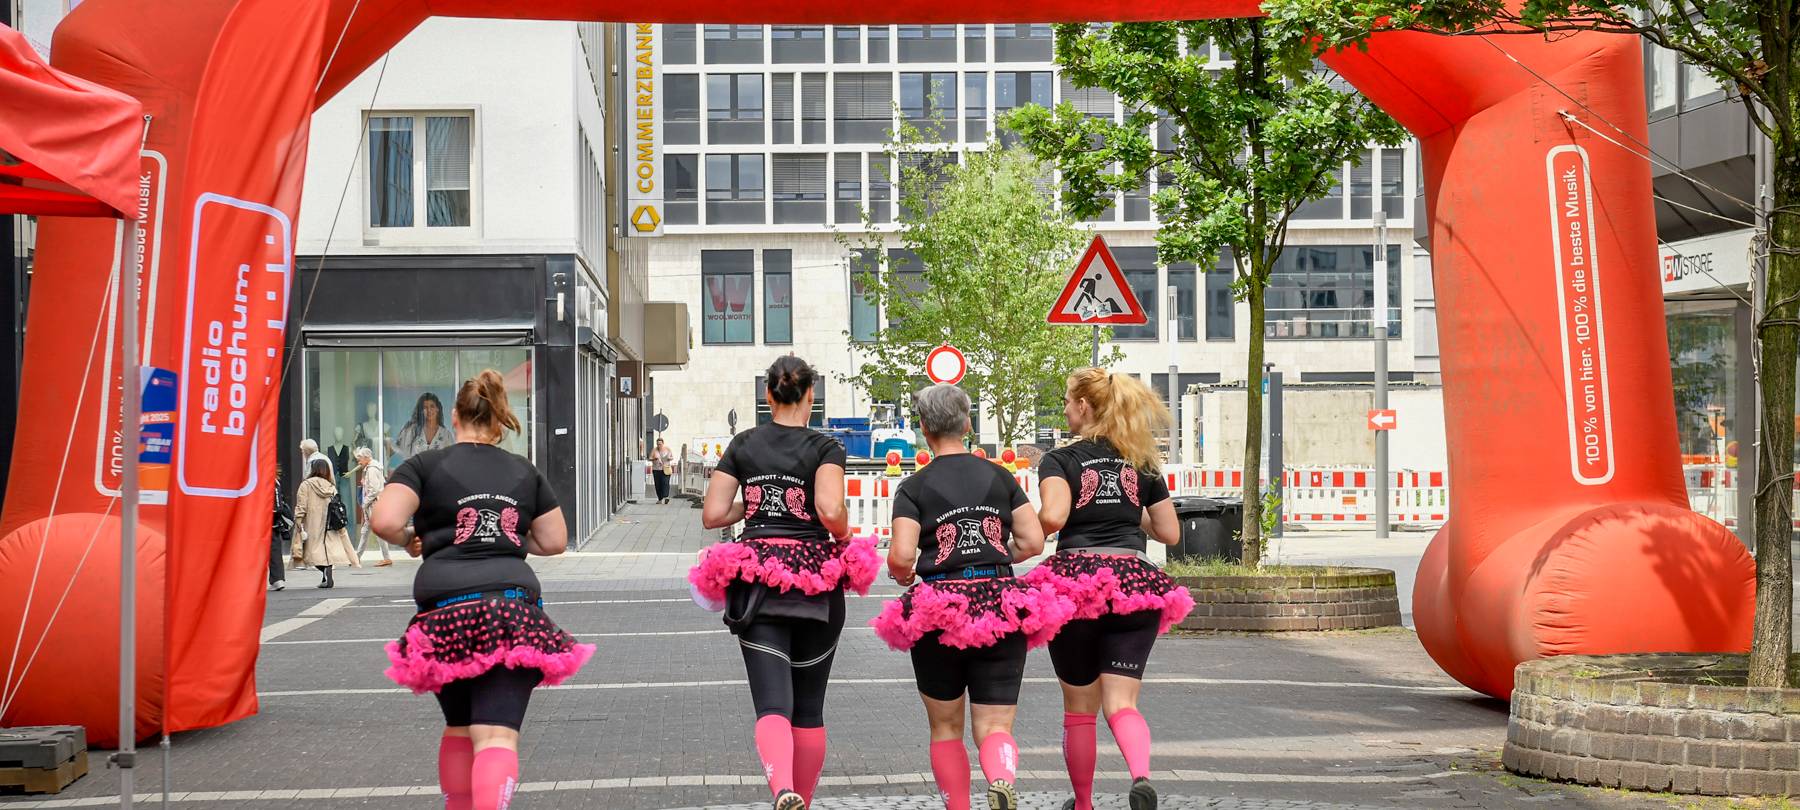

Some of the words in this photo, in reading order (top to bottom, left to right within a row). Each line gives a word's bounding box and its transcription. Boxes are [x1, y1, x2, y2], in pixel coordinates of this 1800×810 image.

[636, 23, 654, 193] COMMERZBANK
[1562, 165, 1580, 218] Musik.
[1568, 221, 1584, 266] beste
[1571, 270, 1587, 293] die
[1573, 296, 1591, 345] 100%
[222, 263, 250, 436] bochum
[1579, 347, 1594, 381] hier.
[201, 320, 223, 433] radio
[1584, 385, 1597, 412] von
[1583, 416, 1600, 466] 100%
[782, 475, 805, 485] ANGELS
[975, 505, 1000, 515] ANGELS
